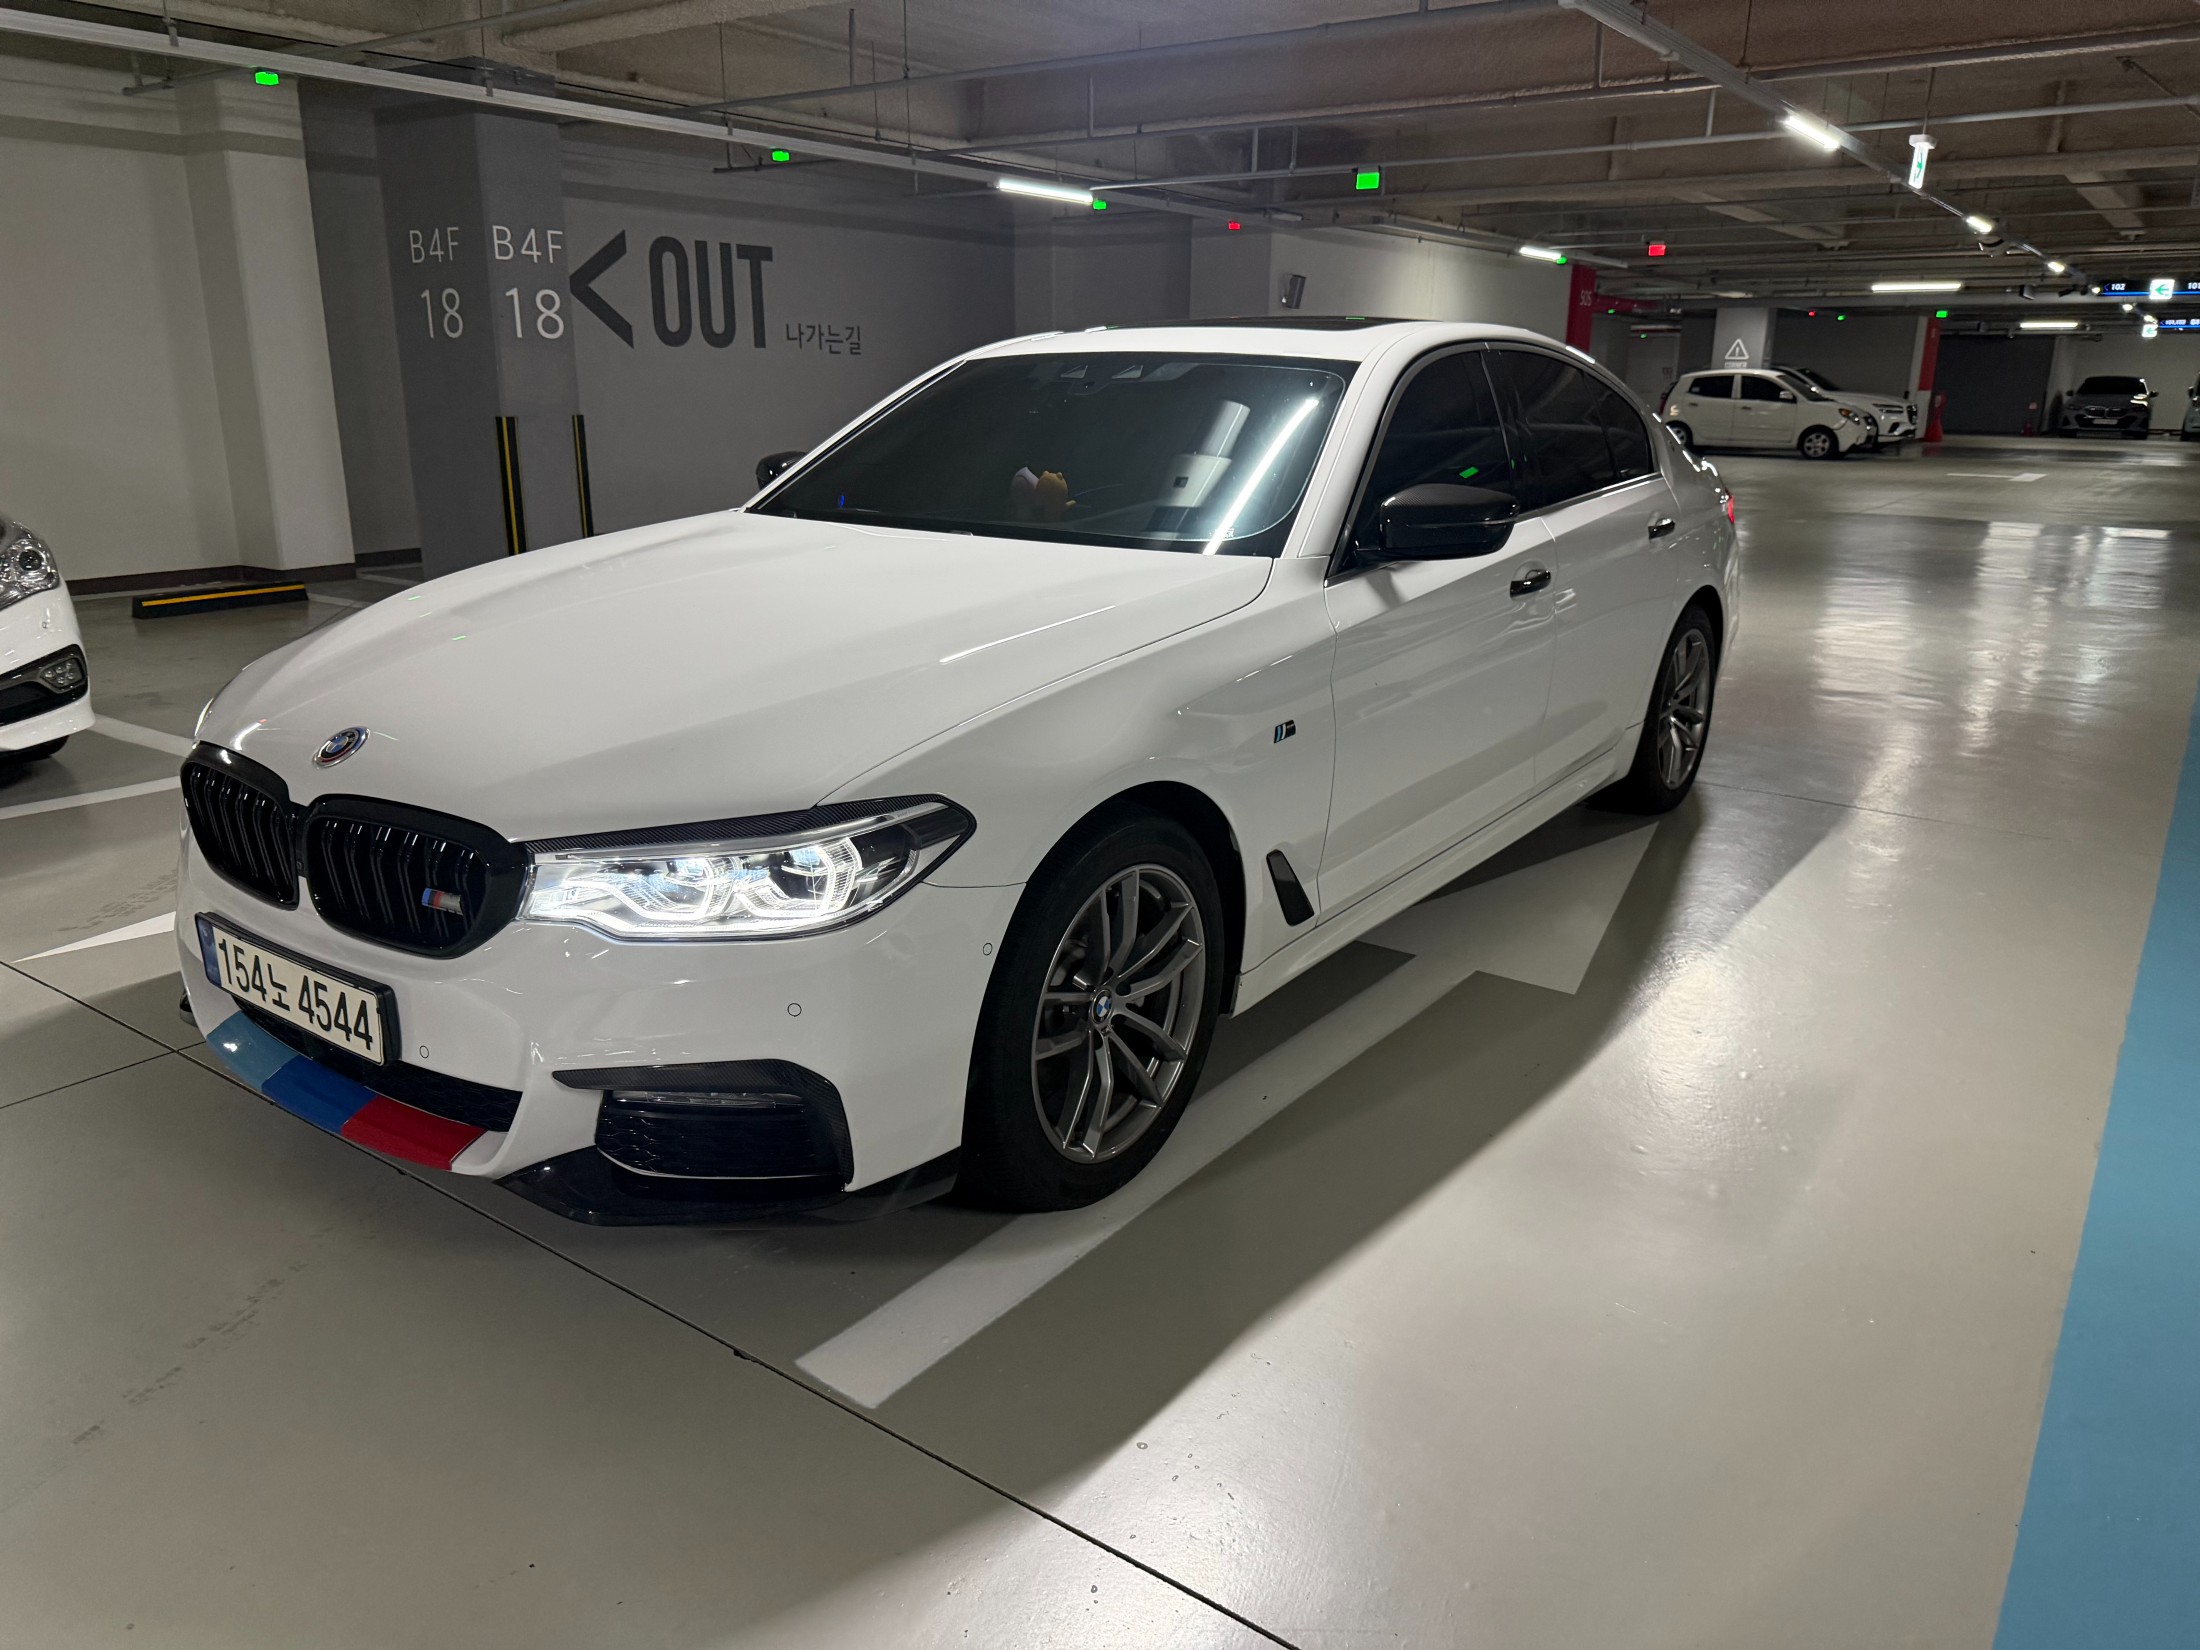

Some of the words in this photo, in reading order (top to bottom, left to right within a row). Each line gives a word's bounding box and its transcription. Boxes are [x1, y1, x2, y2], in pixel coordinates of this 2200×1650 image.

[409, 227, 460, 265] B4F
[492, 225, 564, 264] B4F
[420, 287, 464, 339] 18
[505, 287, 565, 340] 18
[649, 236, 774, 349] OUT
[1580, 289, 1592, 307] SOS
[785, 323, 863, 356] 나가는길
[218, 938, 291, 1012] 154노
[298, 975, 373, 1051] 4544
